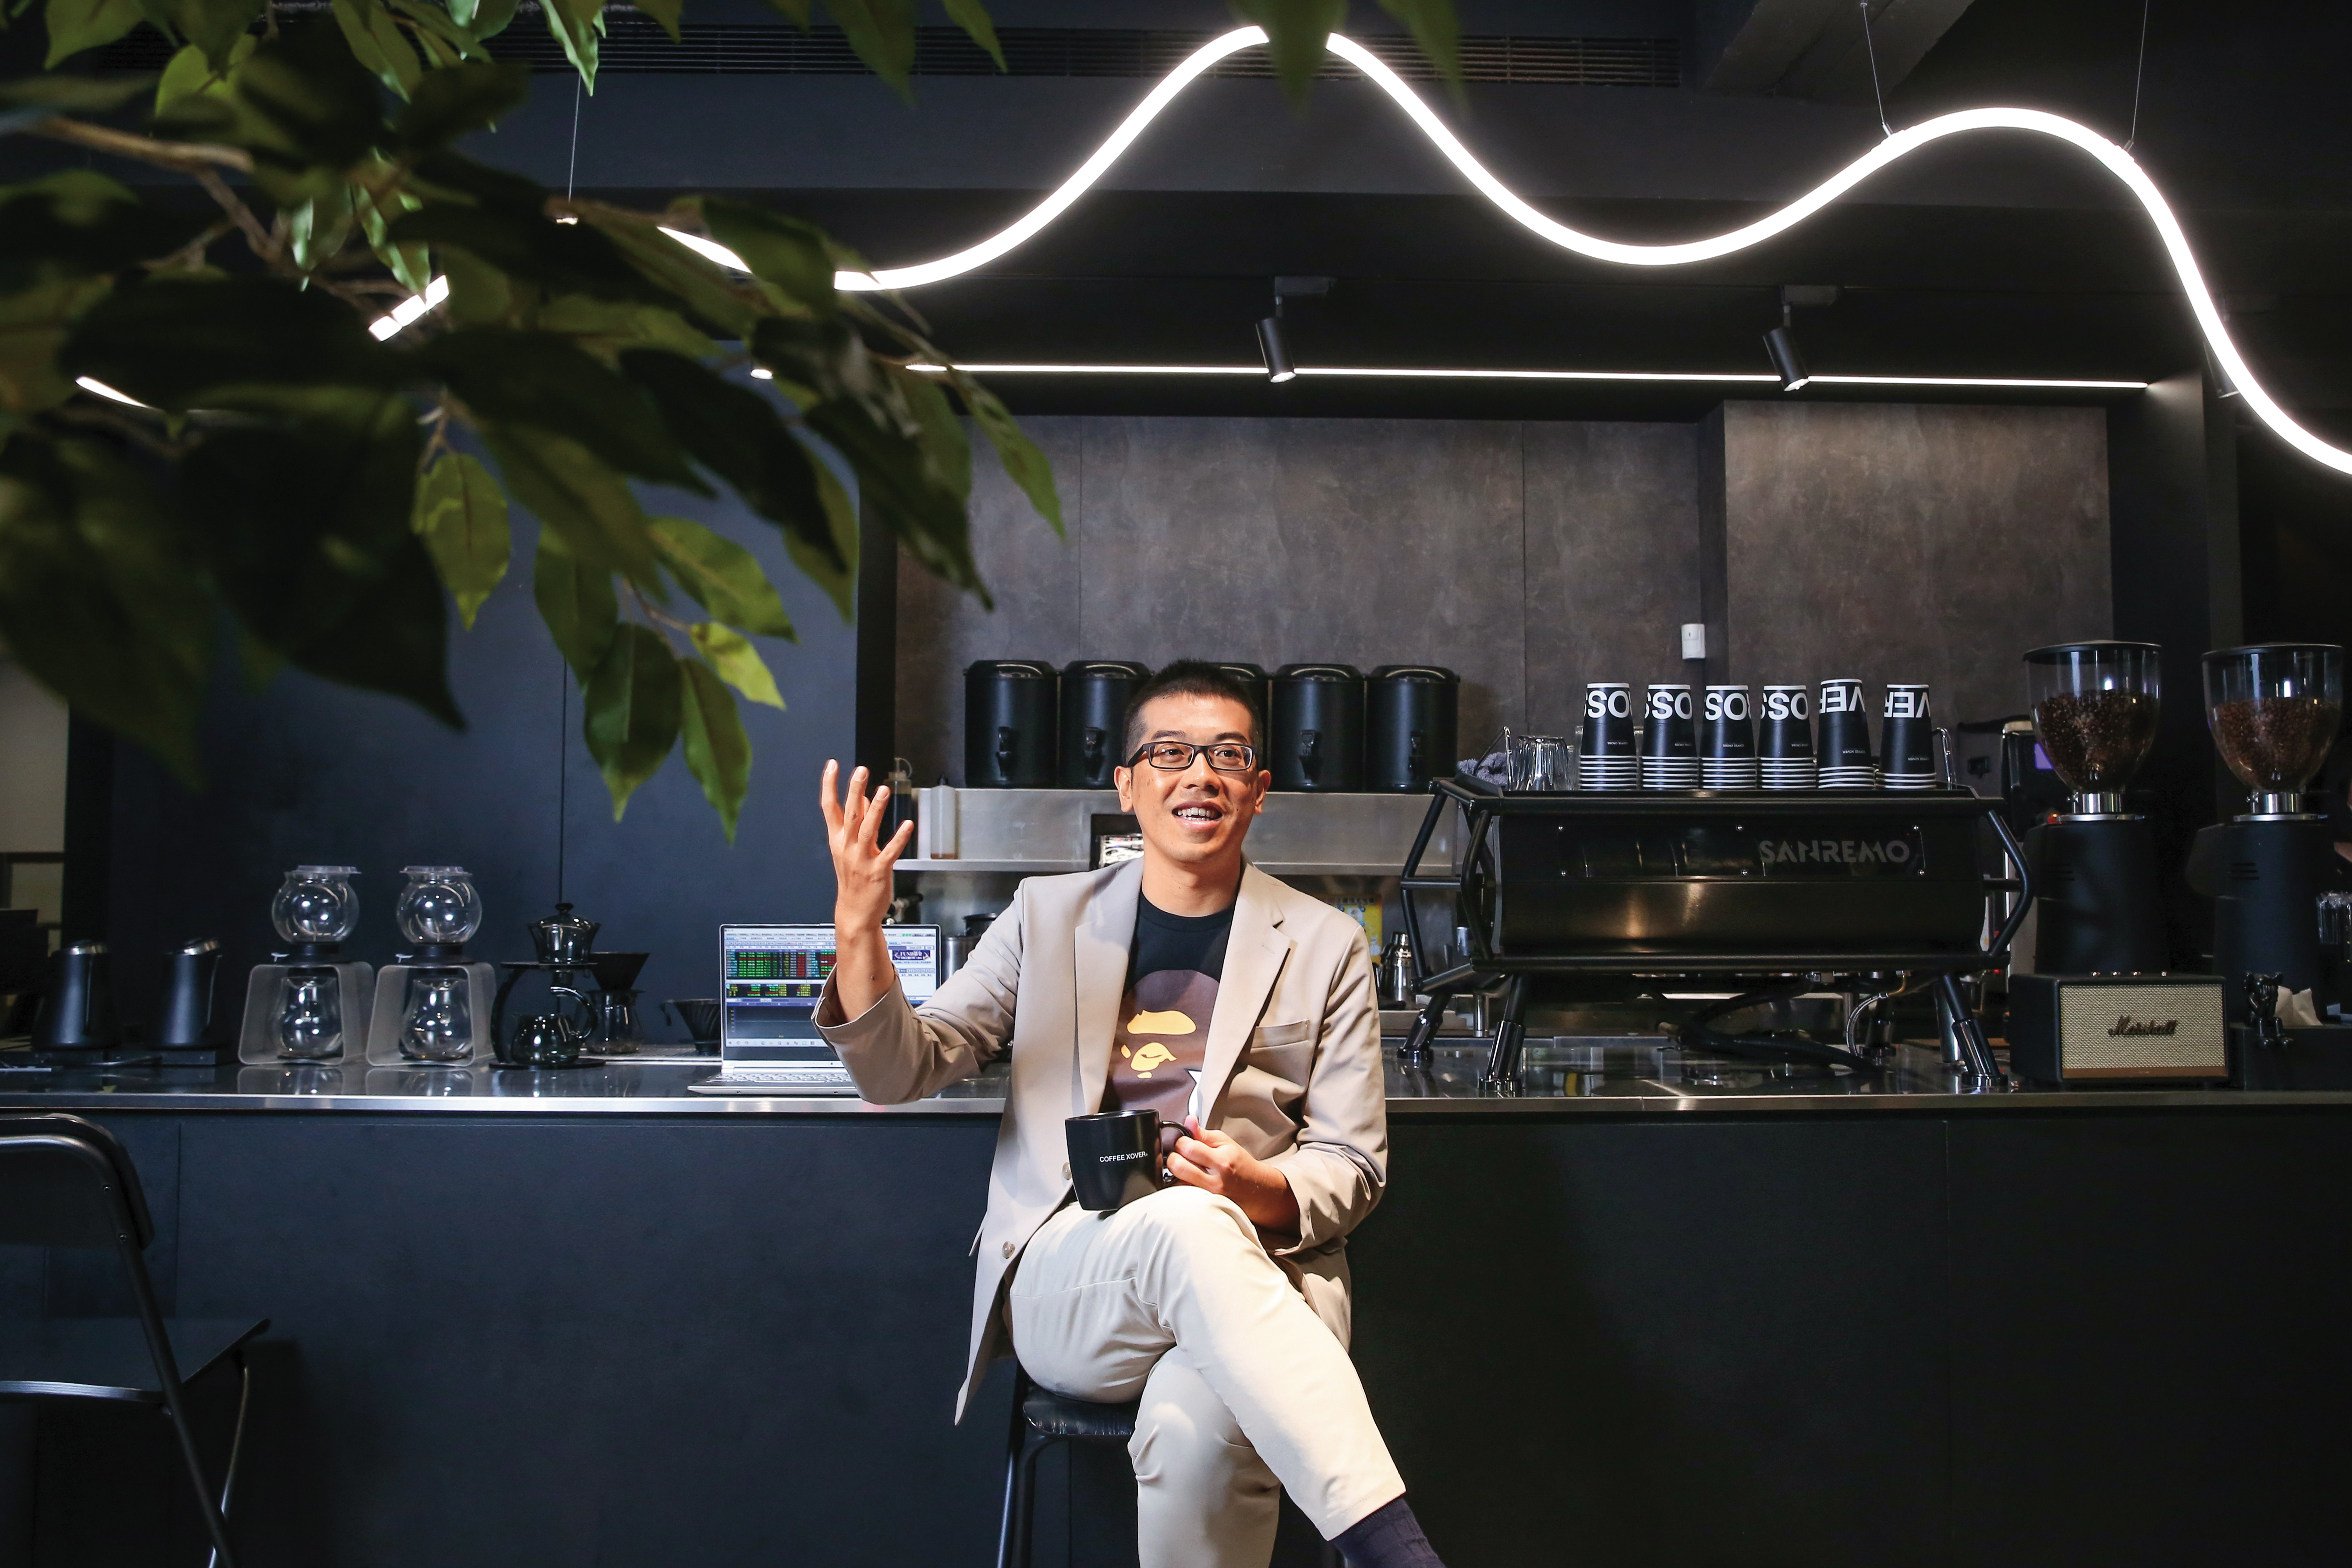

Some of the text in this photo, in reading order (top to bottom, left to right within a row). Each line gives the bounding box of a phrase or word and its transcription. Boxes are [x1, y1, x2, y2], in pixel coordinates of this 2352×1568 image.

[1759, 840, 1910, 863] SANREMO
[2108, 1015, 2177, 1035] Marshall
[1099, 1154, 1125, 1162] COFFEE
